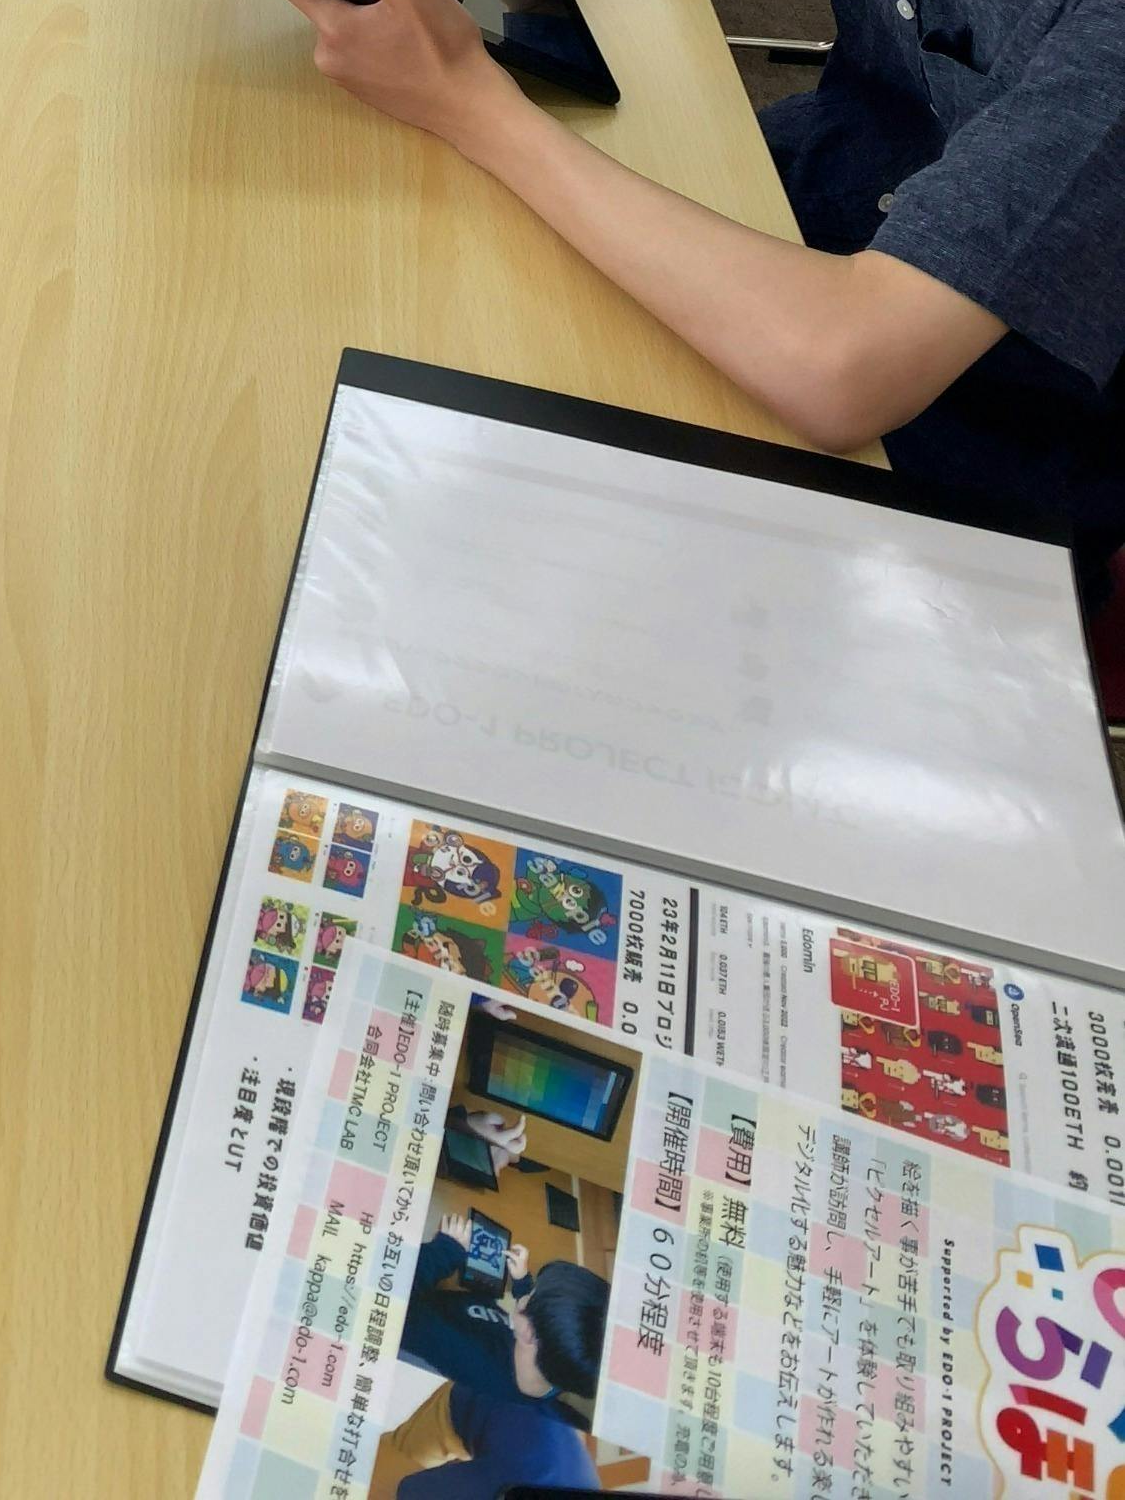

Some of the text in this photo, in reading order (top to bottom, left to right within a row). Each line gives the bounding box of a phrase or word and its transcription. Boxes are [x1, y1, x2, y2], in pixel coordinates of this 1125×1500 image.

[801, 928, 814, 972] Edomin
[1010, 1003, 1023, 1046] OpenSea
[337, 1118, 360, 1151] LAB
[369, 1081, 402, 1153] PROJECT
[276, 1198, 345, 1407] MAIL kappa@edo-1.com
[316, 1210, 375, 1389] HP https://edo-1.com
[768, 1122, 816, 1483] デジタル化する魅力などをお伝えします。
[940, 1238, 955, 1320] Supported
[937, 1327, 953, 1345] by
[938, 1406, 954, 1487] PROJECT
